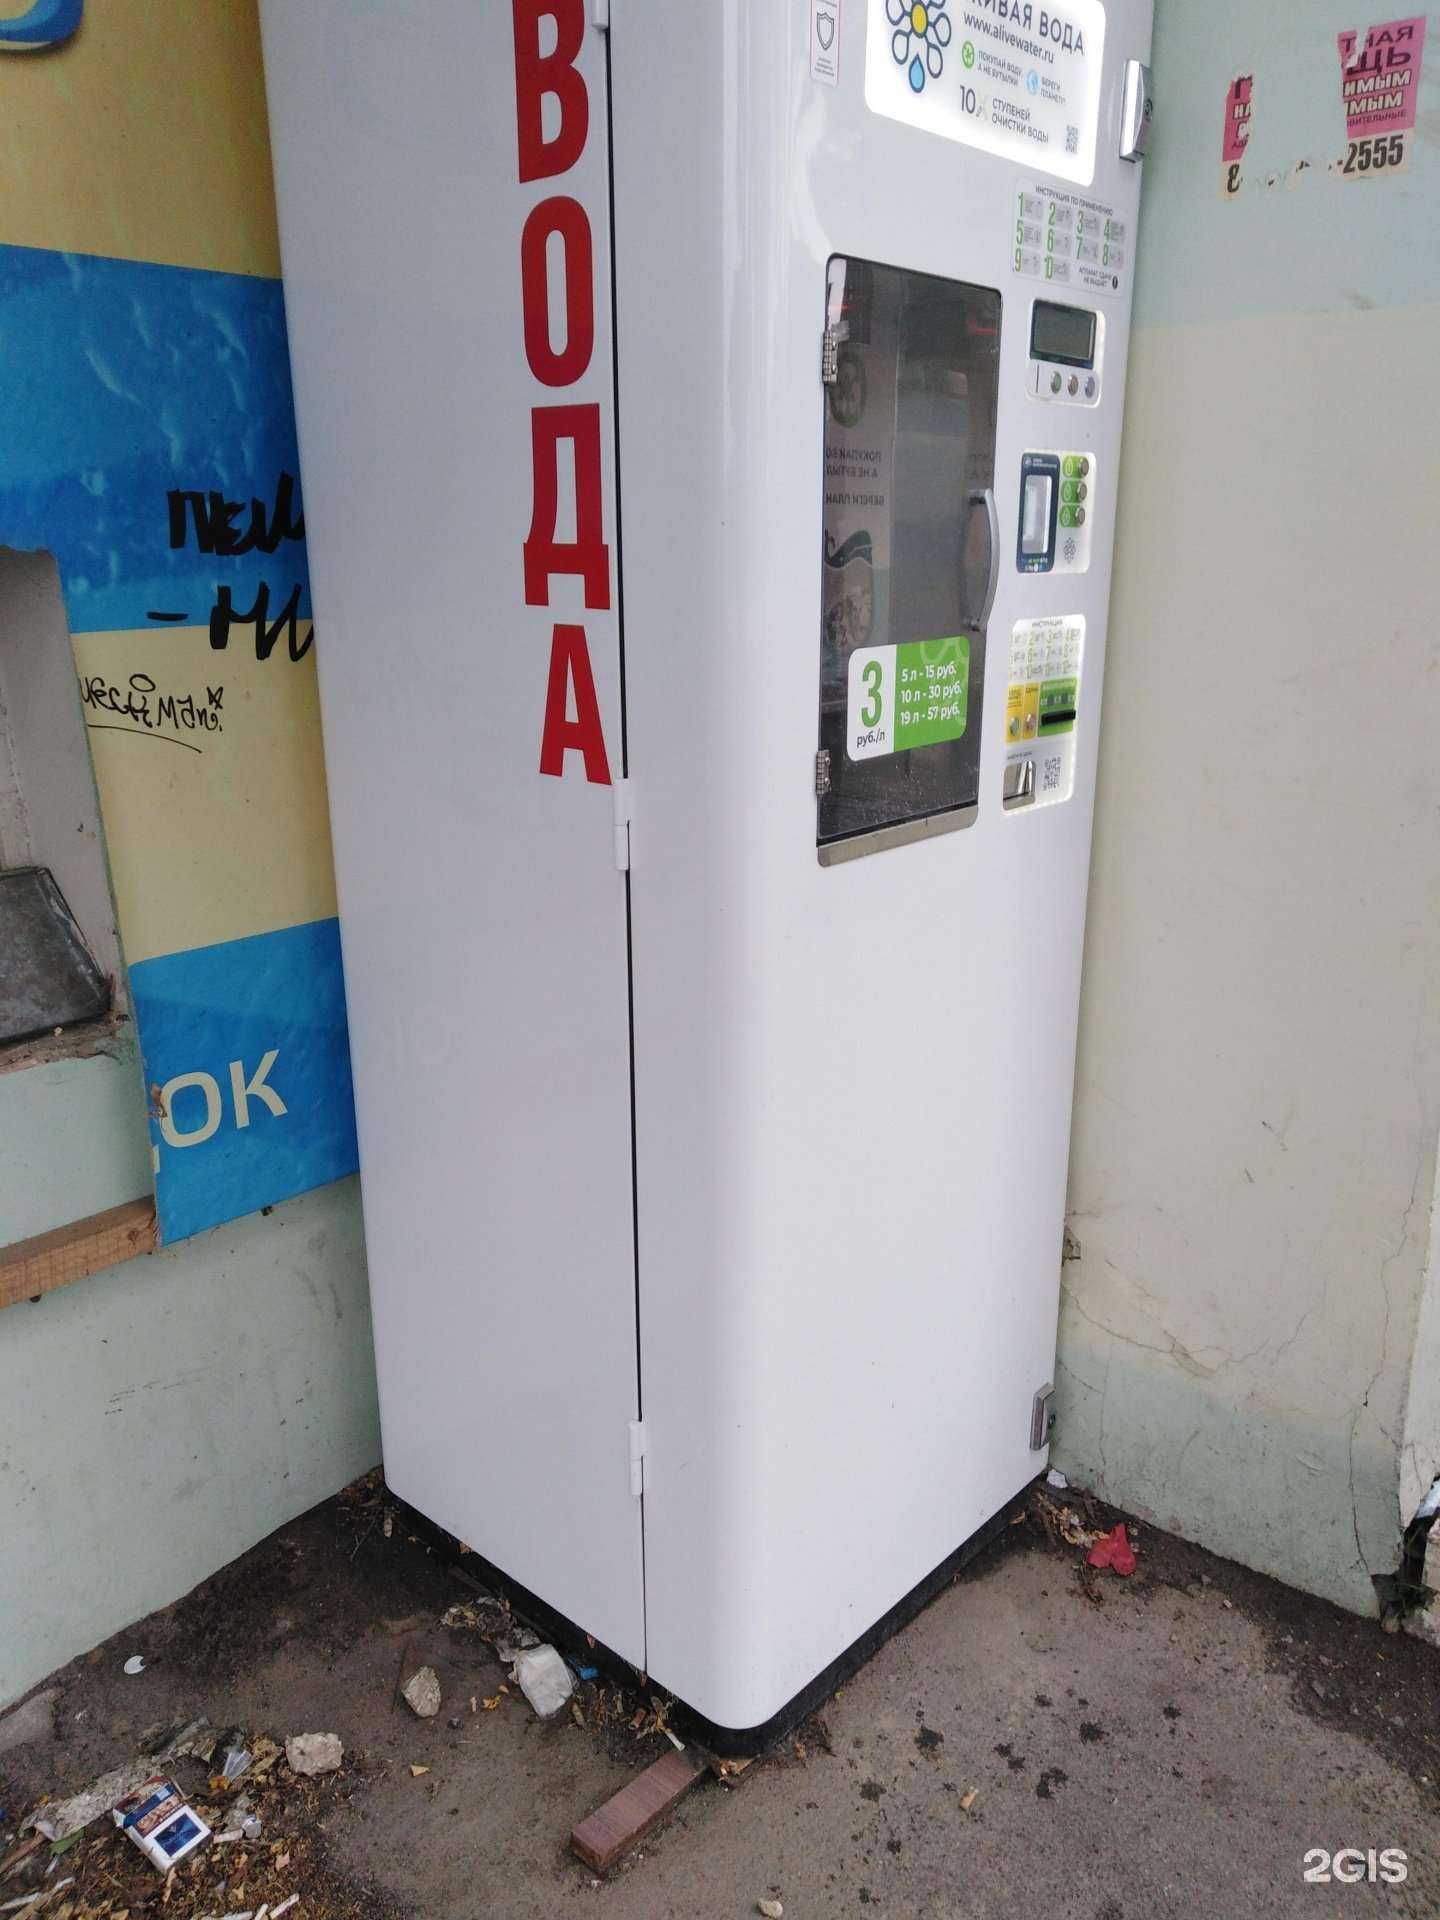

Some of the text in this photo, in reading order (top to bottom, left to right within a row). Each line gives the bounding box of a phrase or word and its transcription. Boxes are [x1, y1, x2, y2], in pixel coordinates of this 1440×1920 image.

[964, 12, 1054, 64] www.alivewater.ru
[969, 0, 1084, 56] ИВАЯ ВОДА
[960, 85, 976, 114] 10
[992, 98, 1031, 121] СТУПЕНЕЙ
[992, 113, 1048, 143] ОЧИСТКИ ВОДЫ
[1018, 193, 1023, 216] 1
[1048, 202, 1055, 225] 2
[1077, 210, 1083, 234] 3
[1016, 220, 1023, 244] 5
[1076, 236, 1082, 259] 7
[1015, 248, 1021, 272] 9
[512, 0, 612, 785] ВОДА
[901, 669, 909, 682] 5
[910, 671, 917, 681] л
[925, 665, 935, 679] 15
[937, 661, 957, 679] руб.
[861, 661, 882, 728] 3
[901, 690, 912, 703] 10
[913, 692, 920, 701] л
[928, 685, 941, 699] 30
[943, 681, 962, 699] руб.
[900, 711, 911, 725] 19
[912, 713, 920, 723] л
[927, 705, 938, 720] 57
[940, 703, 960, 720] руб.
[857, 728, 885, 748] руб./л
